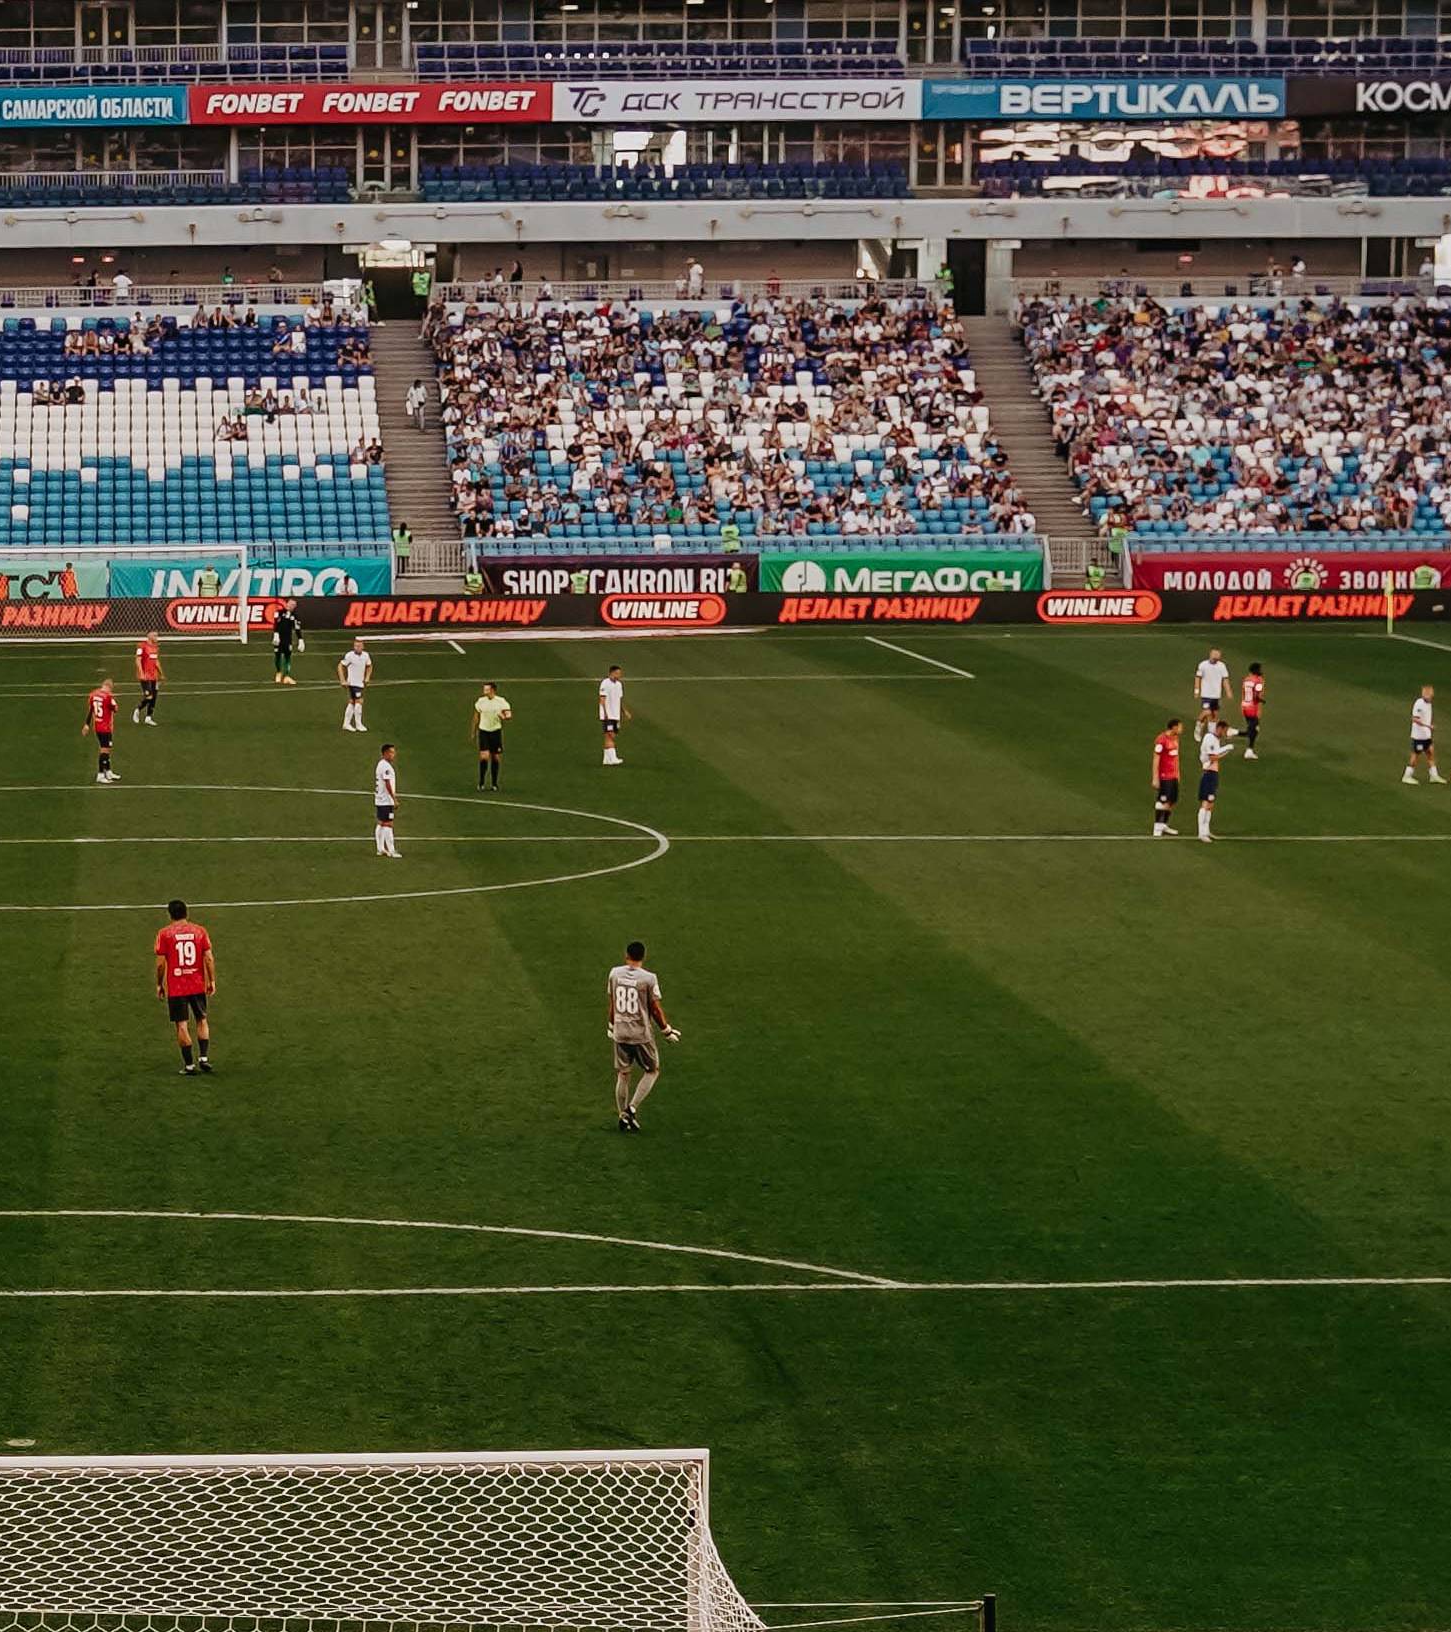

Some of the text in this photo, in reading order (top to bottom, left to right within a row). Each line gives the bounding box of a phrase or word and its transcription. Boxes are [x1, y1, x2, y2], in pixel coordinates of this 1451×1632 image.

[2, 95, 98, 120] САМАРСКОЙ
[100, 97, 174, 119] ОБЛАСТИ
[206, 90, 536, 114] FONBET FONBET FONBET
[621, 92, 679, 111] ДСК
[695, 84, 905, 113] ТРАНССТРОЙ
[1163, 568, 1273, 591] МОЛОДОЙ
[4, 604, 110, 632] РАЗНИЦУ
[176, 605, 263, 622] WINLINE
[344, 600, 546, 625] ДЕЛАЕТ РАЗНИЦУ
[611, 601, 699, 618] WINLINE
[778, 597, 982, 622] ДЕЛАЕТ РАЗНИЦУ
[1046, 598, 1135, 616] WINLINE
[1213, 593, 1415, 620] ДЕЛАЕТ РАЗНИЦУ
[175, 941, 196, 966] 19
[615, 987, 639, 1014] 88
